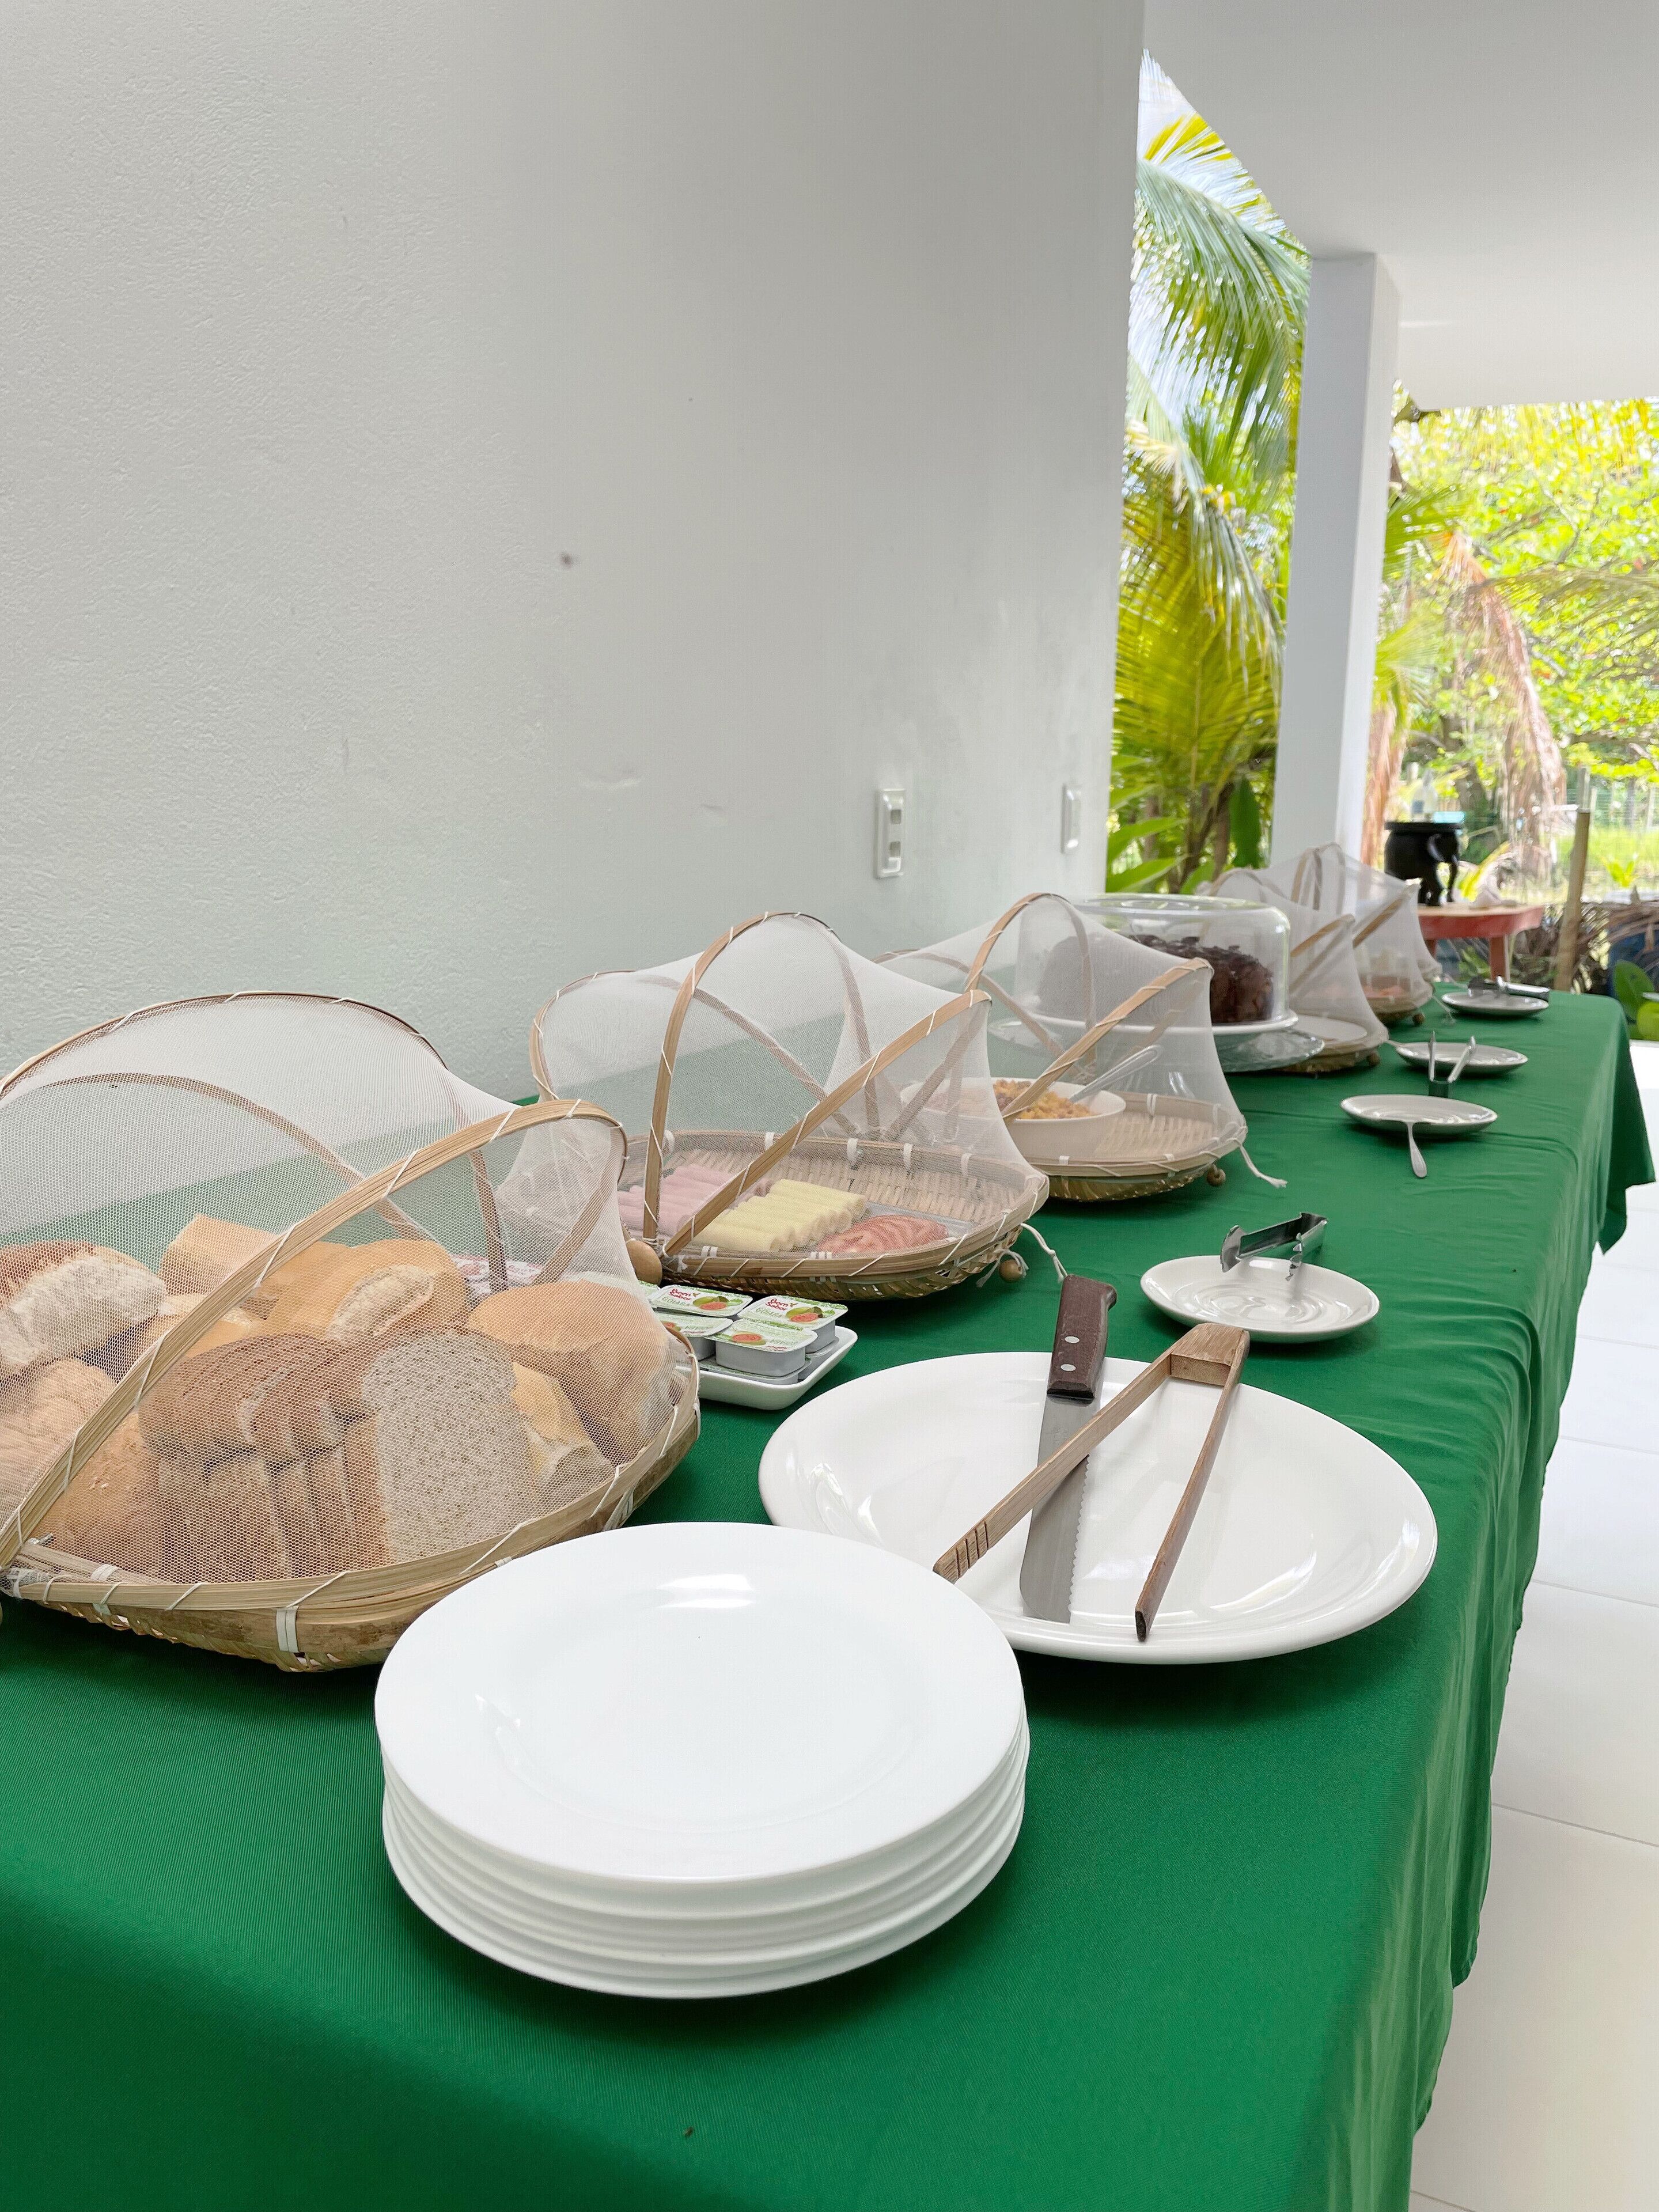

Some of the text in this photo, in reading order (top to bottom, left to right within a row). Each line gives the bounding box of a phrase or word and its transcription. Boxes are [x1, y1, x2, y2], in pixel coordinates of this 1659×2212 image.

[670, 1292, 692, 1300] Sabor
[766, 1302, 787, 1310] Sabor
[771, 1298, 788, 1307] Bom
